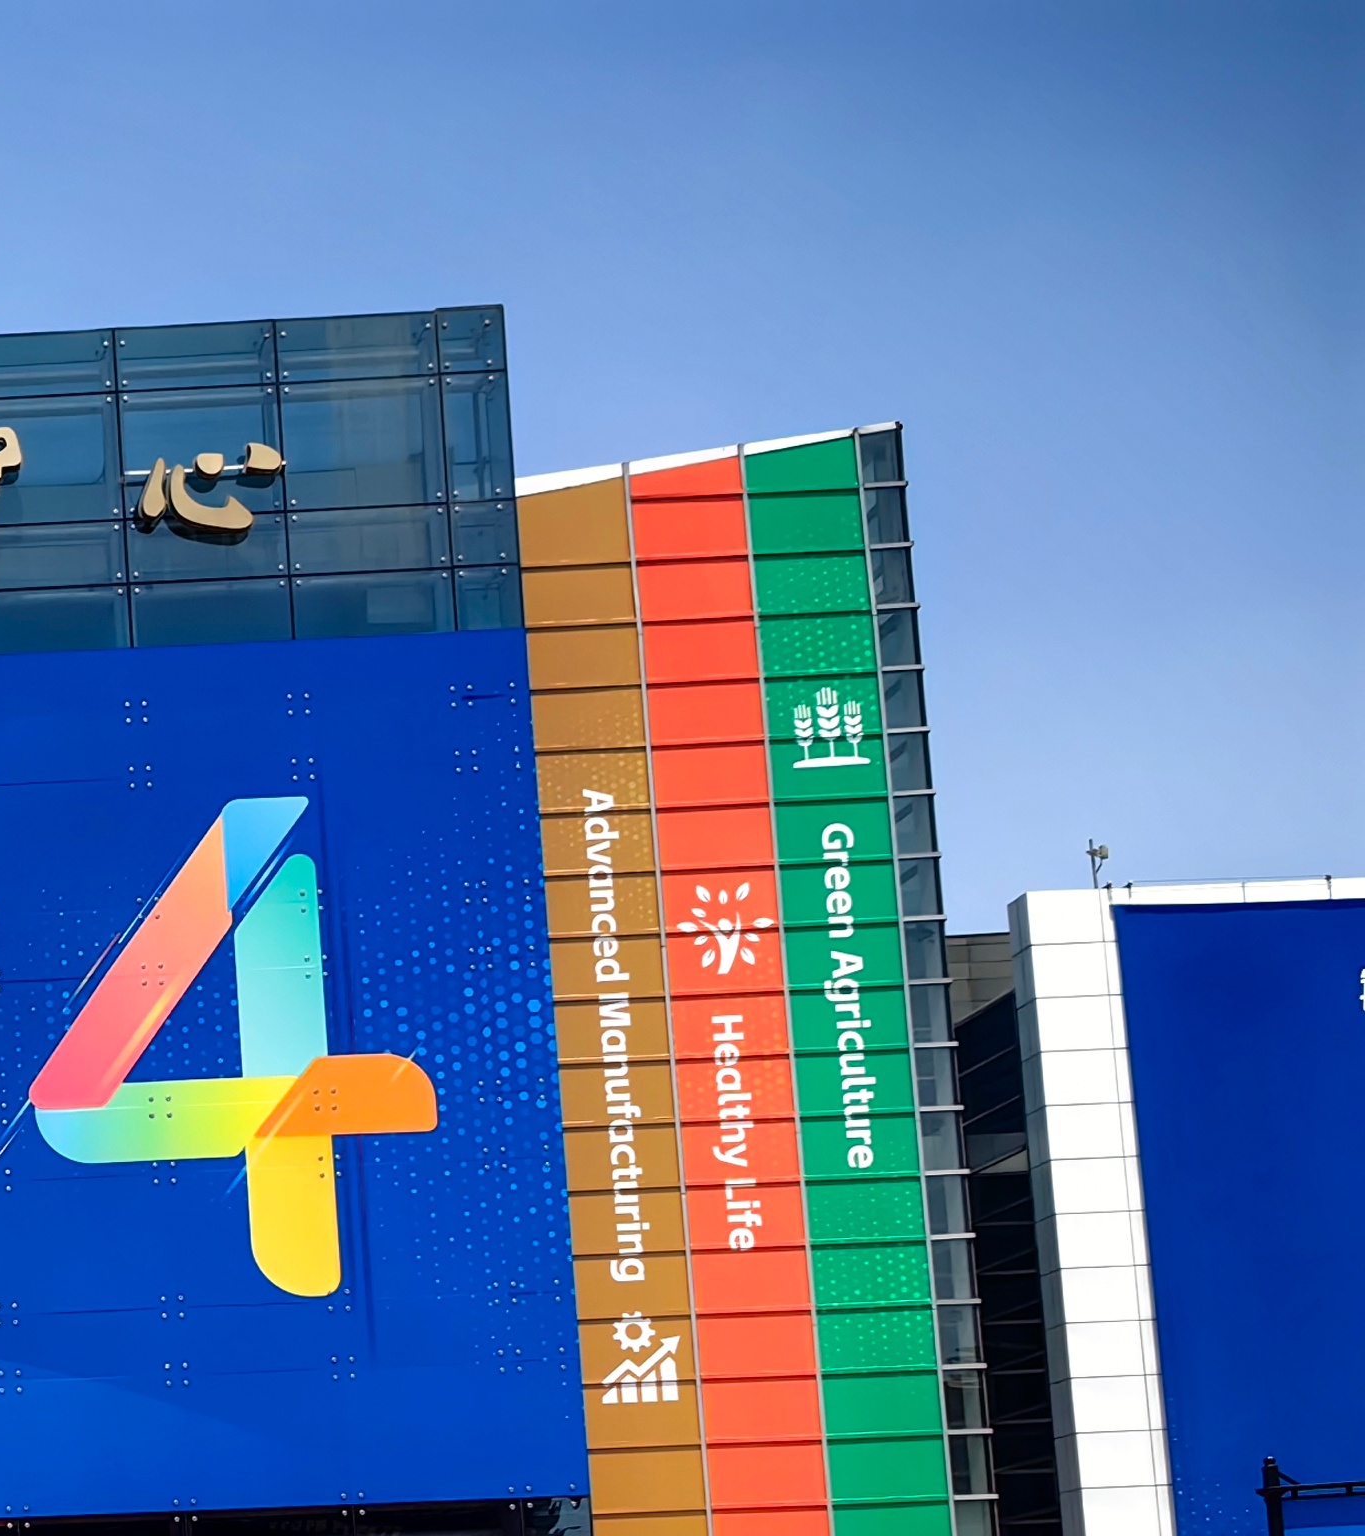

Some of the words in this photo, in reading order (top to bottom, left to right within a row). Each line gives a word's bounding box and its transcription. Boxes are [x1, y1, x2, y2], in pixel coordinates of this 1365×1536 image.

[580, 786, 631, 983] Advanced
[821, 822, 855, 939] Green
[595, 990, 650, 1283] Manufacturing
[710, 1013, 754, 1168] Healthy
[823, 950, 877, 1169] Agriculture
[724, 1178, 762, 1253] Life
